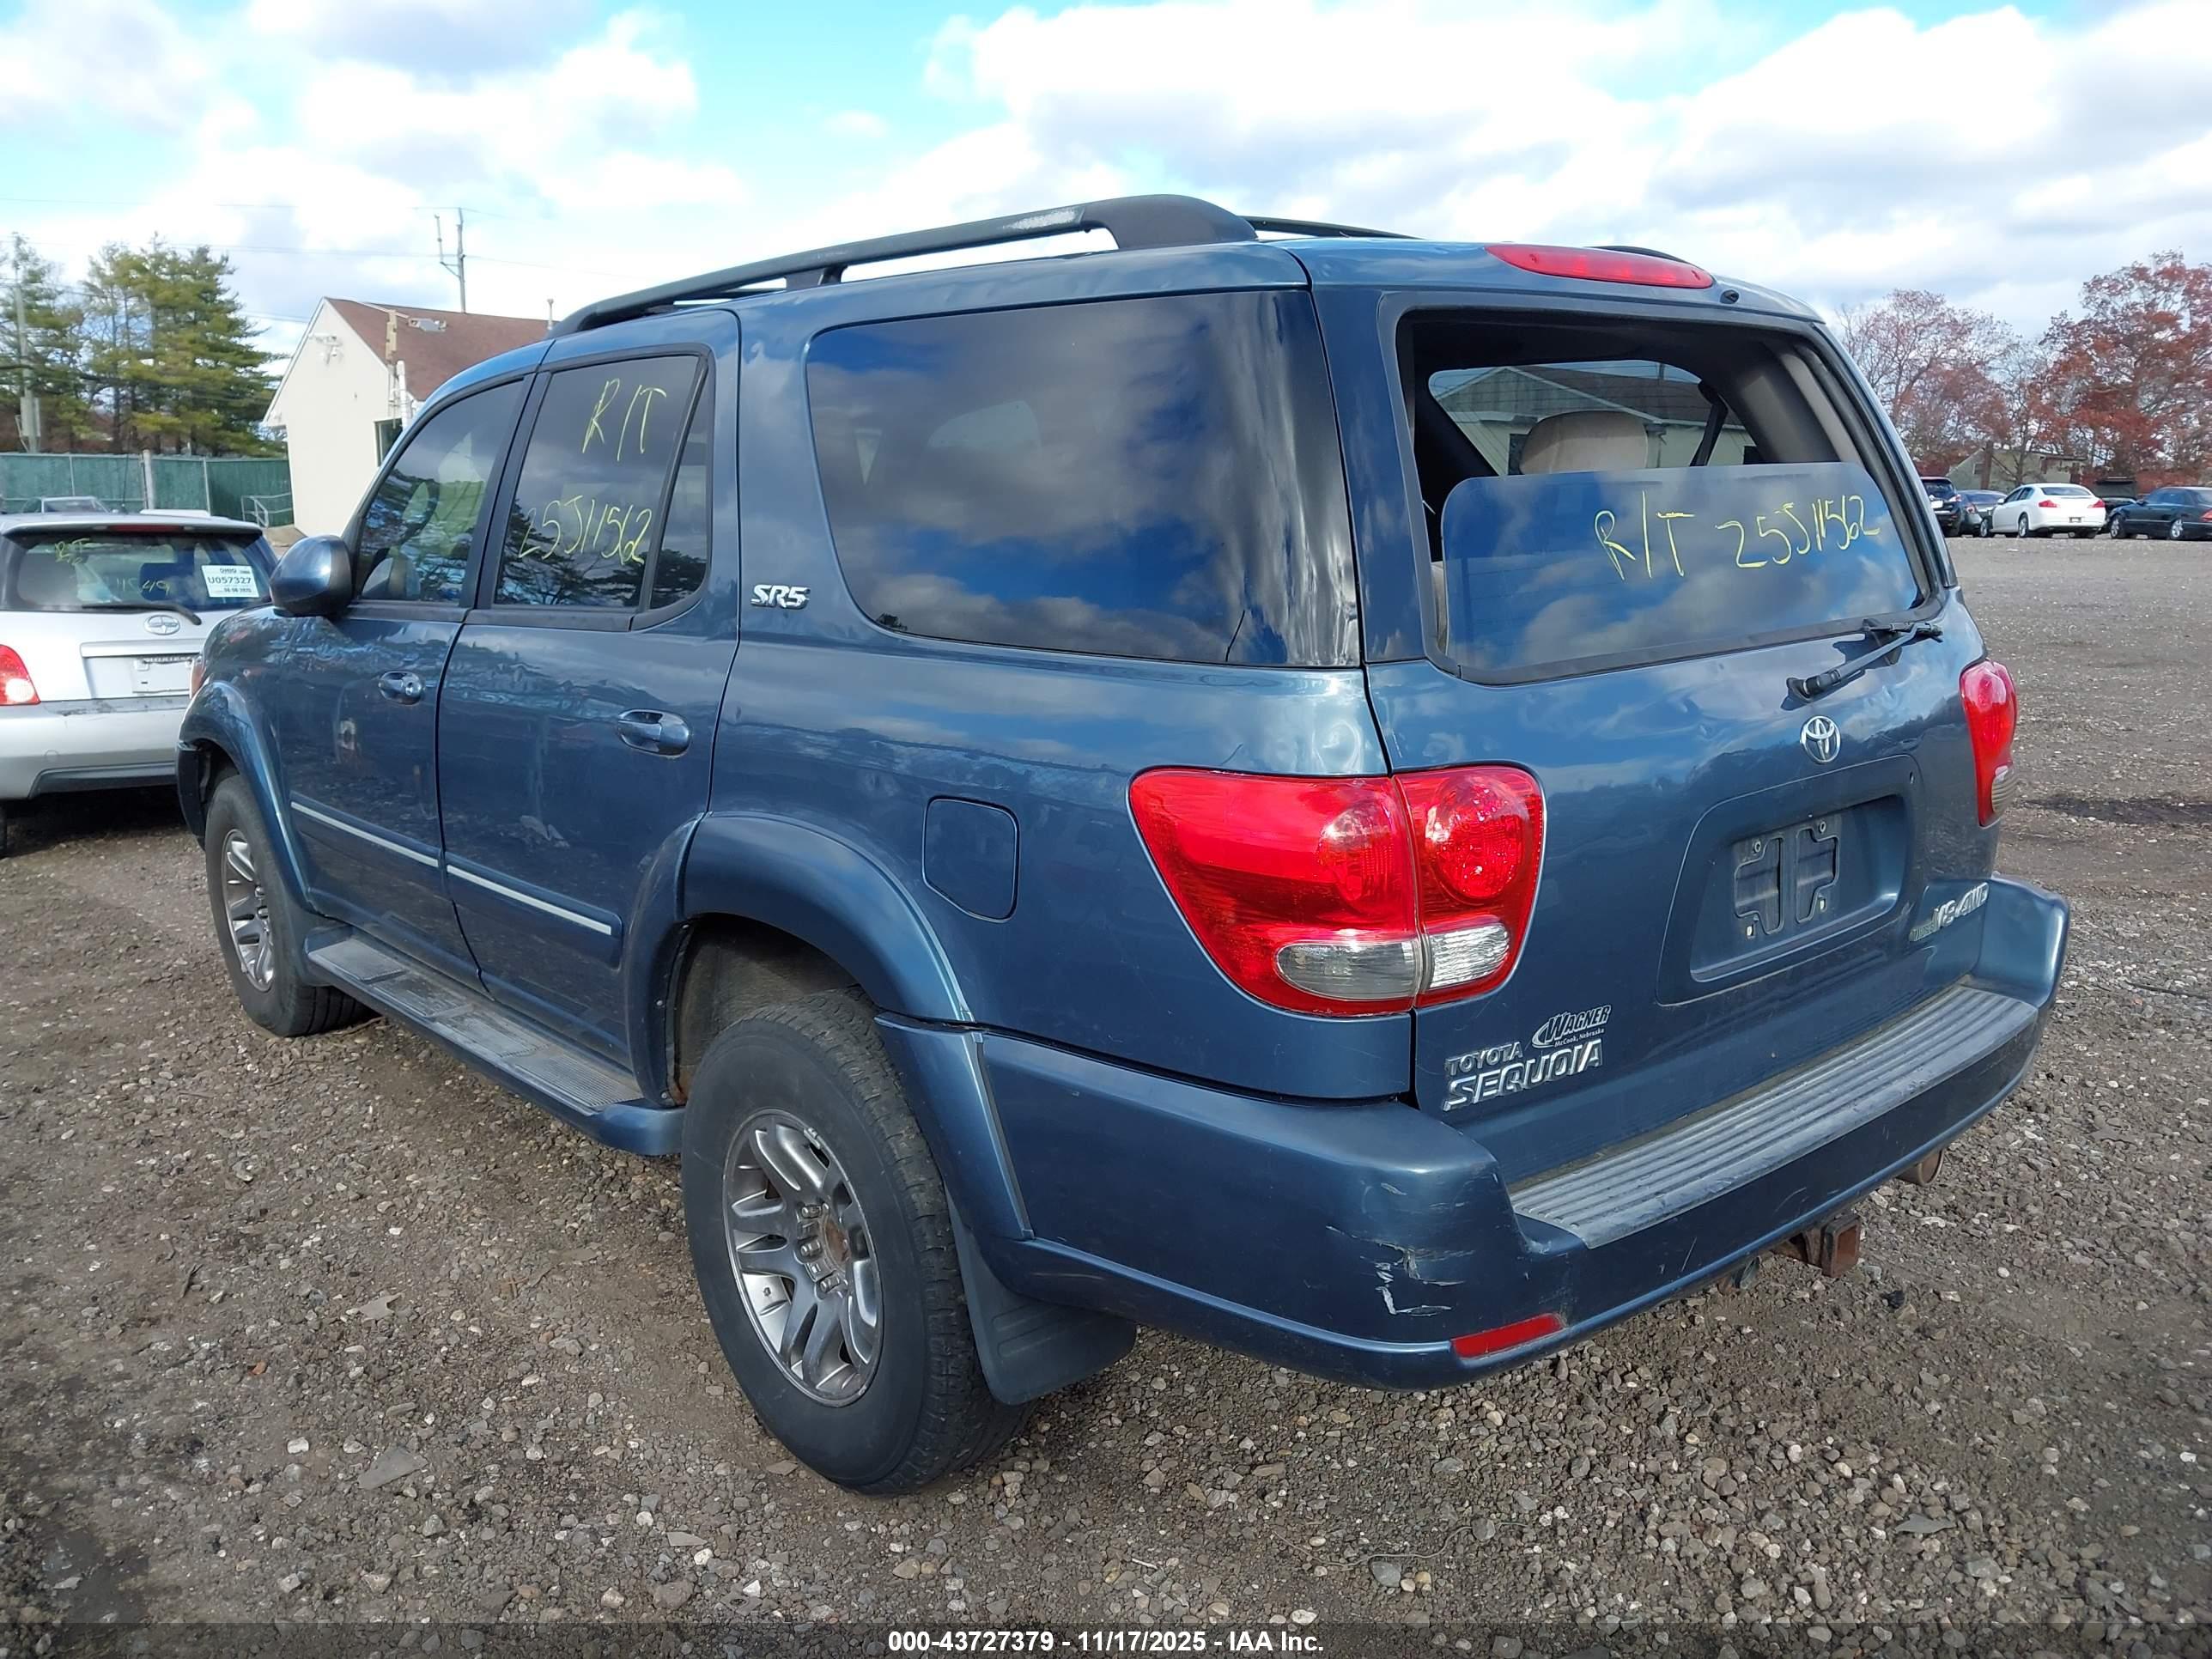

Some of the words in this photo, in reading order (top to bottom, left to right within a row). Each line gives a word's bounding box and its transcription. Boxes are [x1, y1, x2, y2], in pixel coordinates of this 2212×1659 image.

[750, 584, 811, 610] SR5
[1578, 1027, 1605, 1040] Nebraska
[1444, 1041, 1523, 1076] TOYOTA
[1442, 1038, 1603, 1112] SEQUOIA
